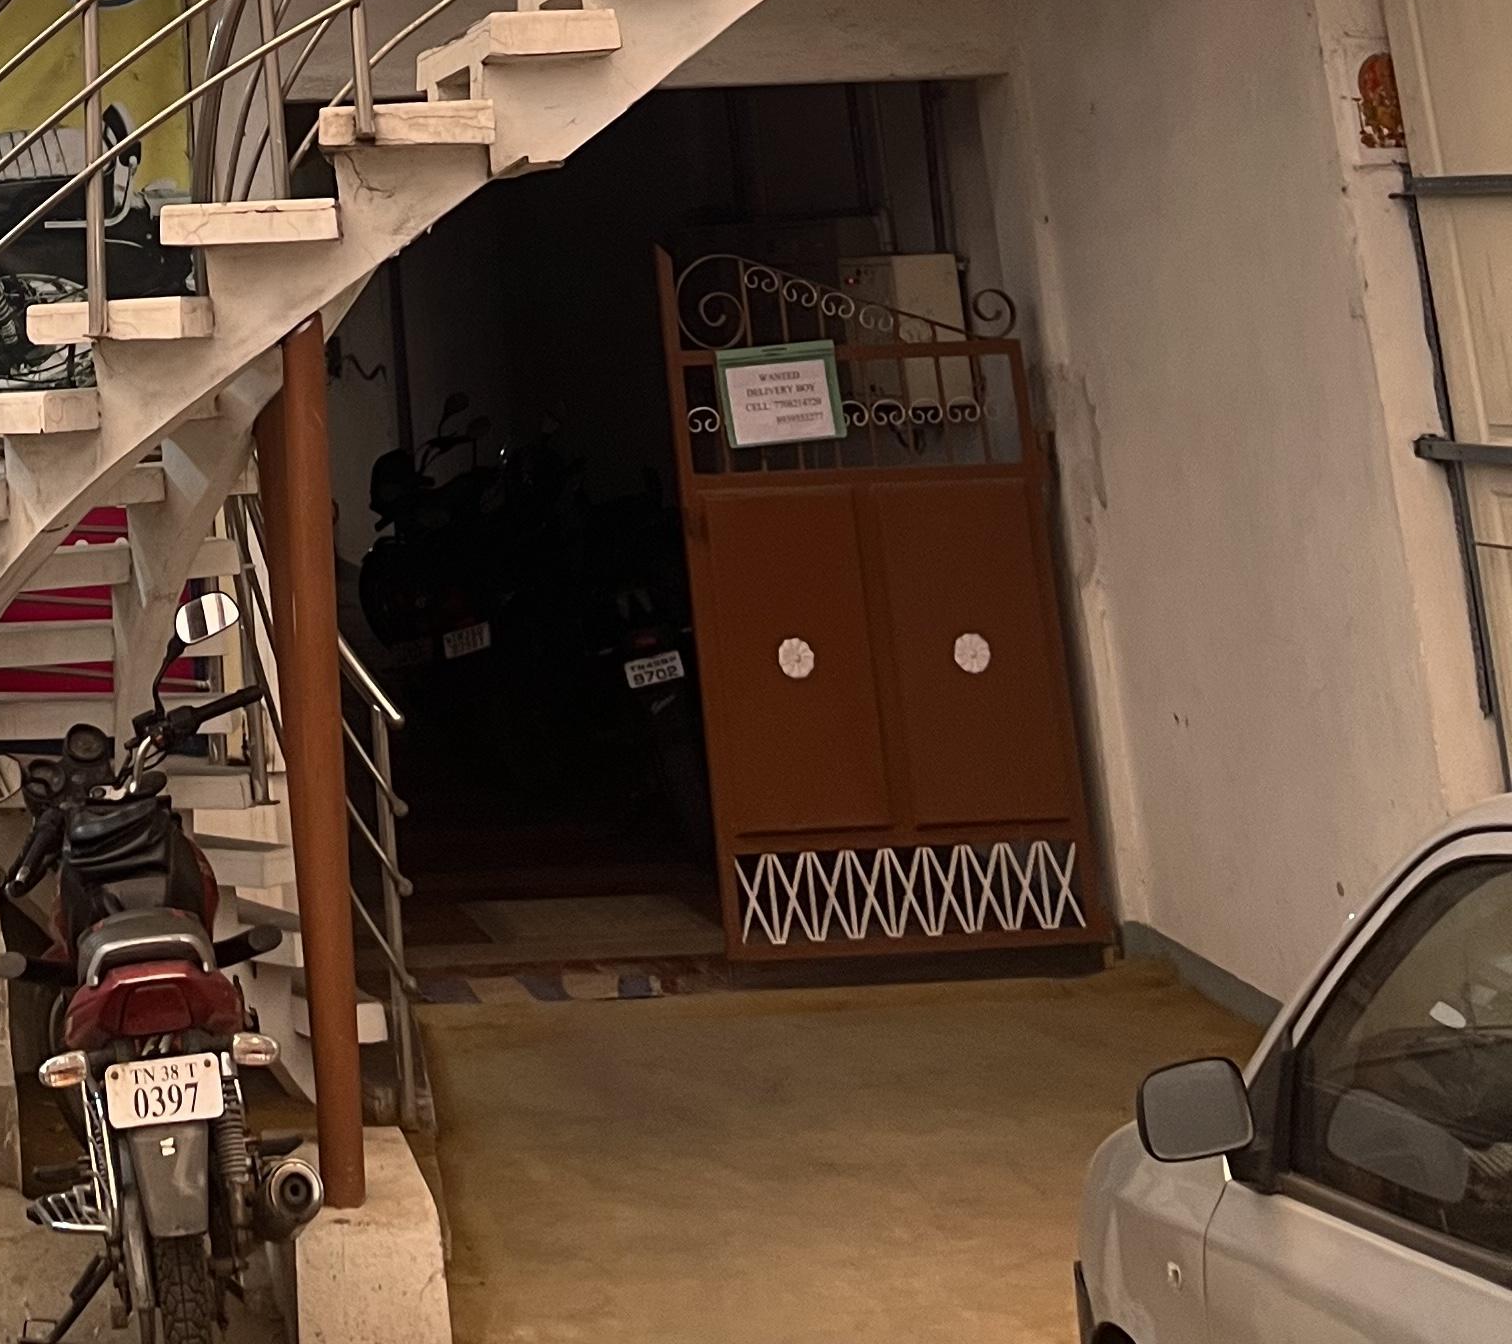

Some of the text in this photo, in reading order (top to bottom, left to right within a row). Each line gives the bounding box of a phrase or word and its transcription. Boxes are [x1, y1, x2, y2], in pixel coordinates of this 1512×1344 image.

[758, 370, 800, 381] WANTED
[746, 382, 815, 397] DELIVERY BOY
[131, 1062, 198, 1084] TN 38 T
[133, 1081, 199, 1119] 0397
